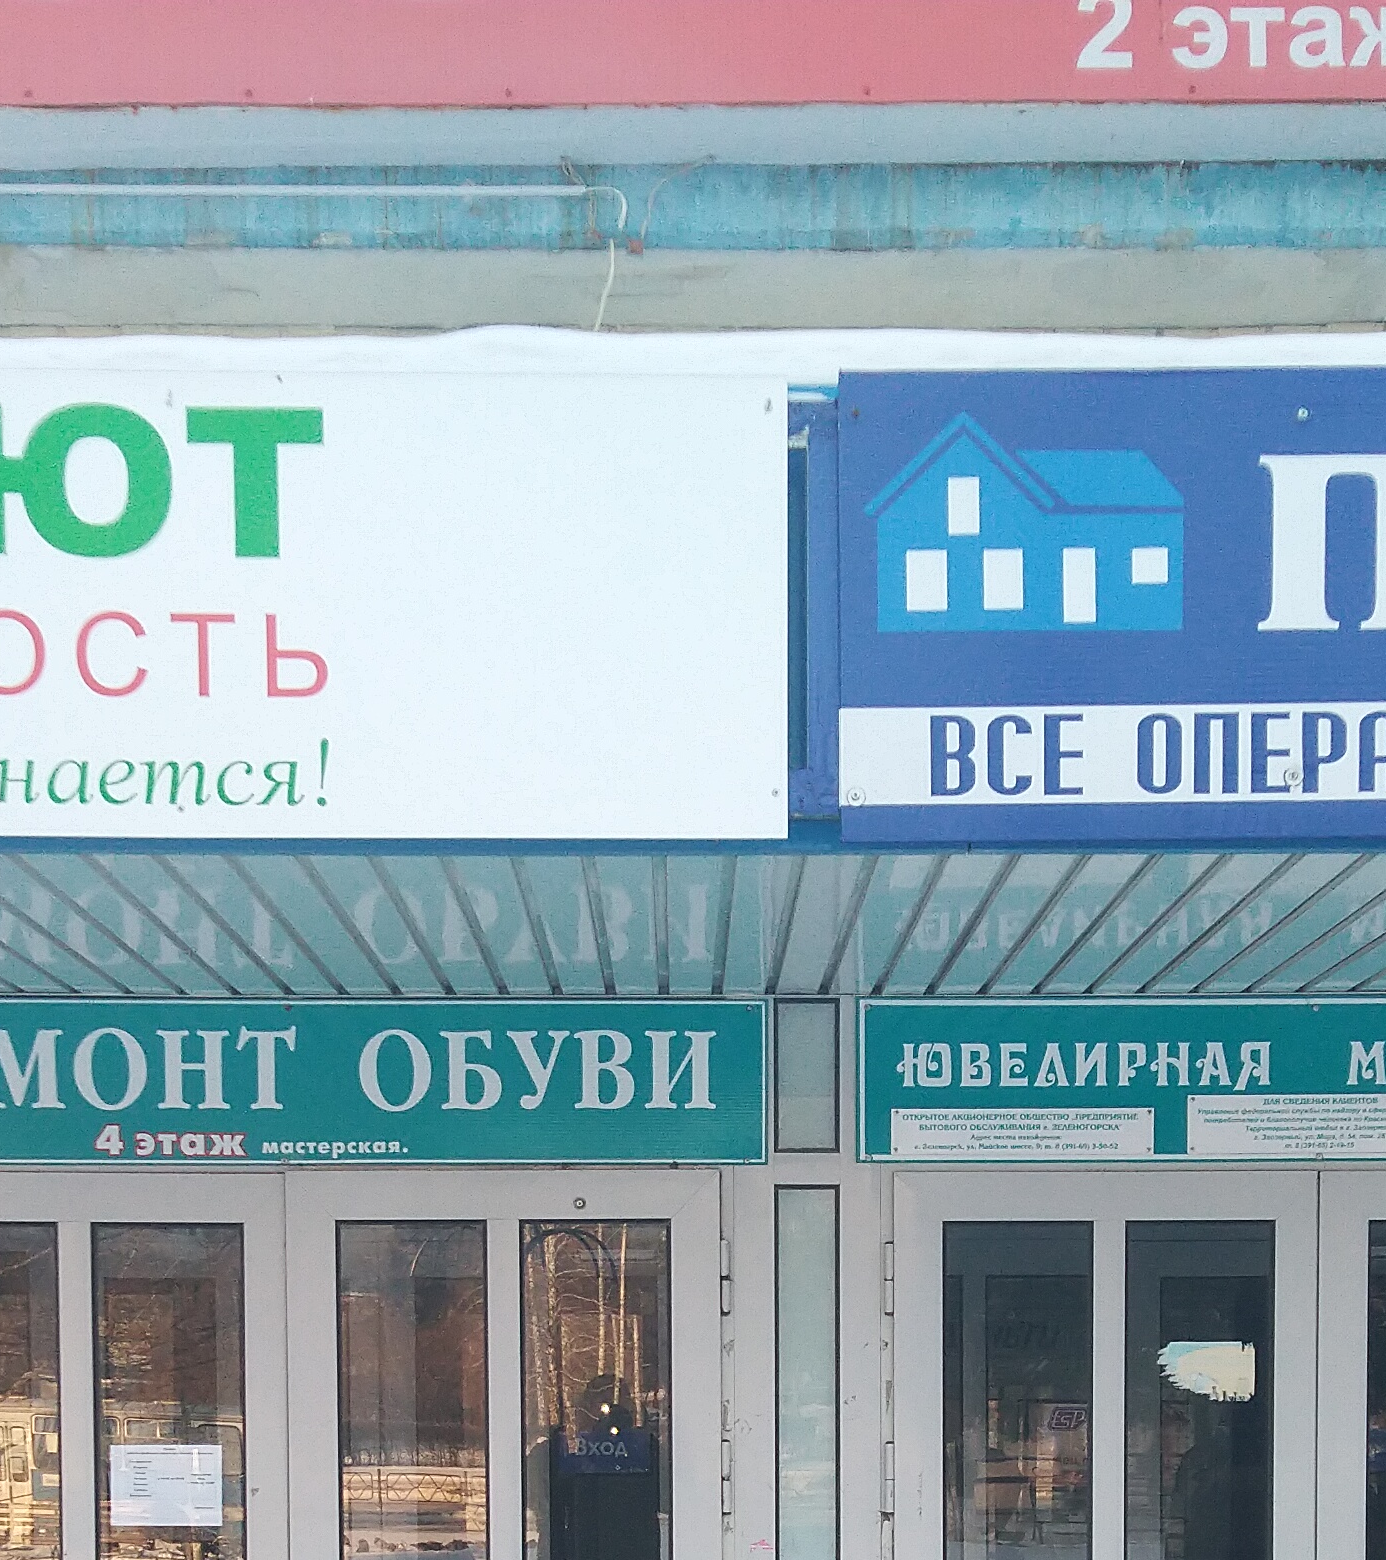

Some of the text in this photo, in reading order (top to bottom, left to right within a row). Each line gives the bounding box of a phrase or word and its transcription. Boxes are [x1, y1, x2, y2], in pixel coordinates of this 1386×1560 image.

[1075, 0, 1132, 69] 2
[929, 711, 1083, 797] ВСЕ
[359, 1027, 717, 1112] ОБУВИ
[897, 1040, 1272, 1090] ЮВЕЛИРНАЯ
[95, 1124, 247, 1158] 4 этаж
[261, 1138, 410, 1158] мастерская.
